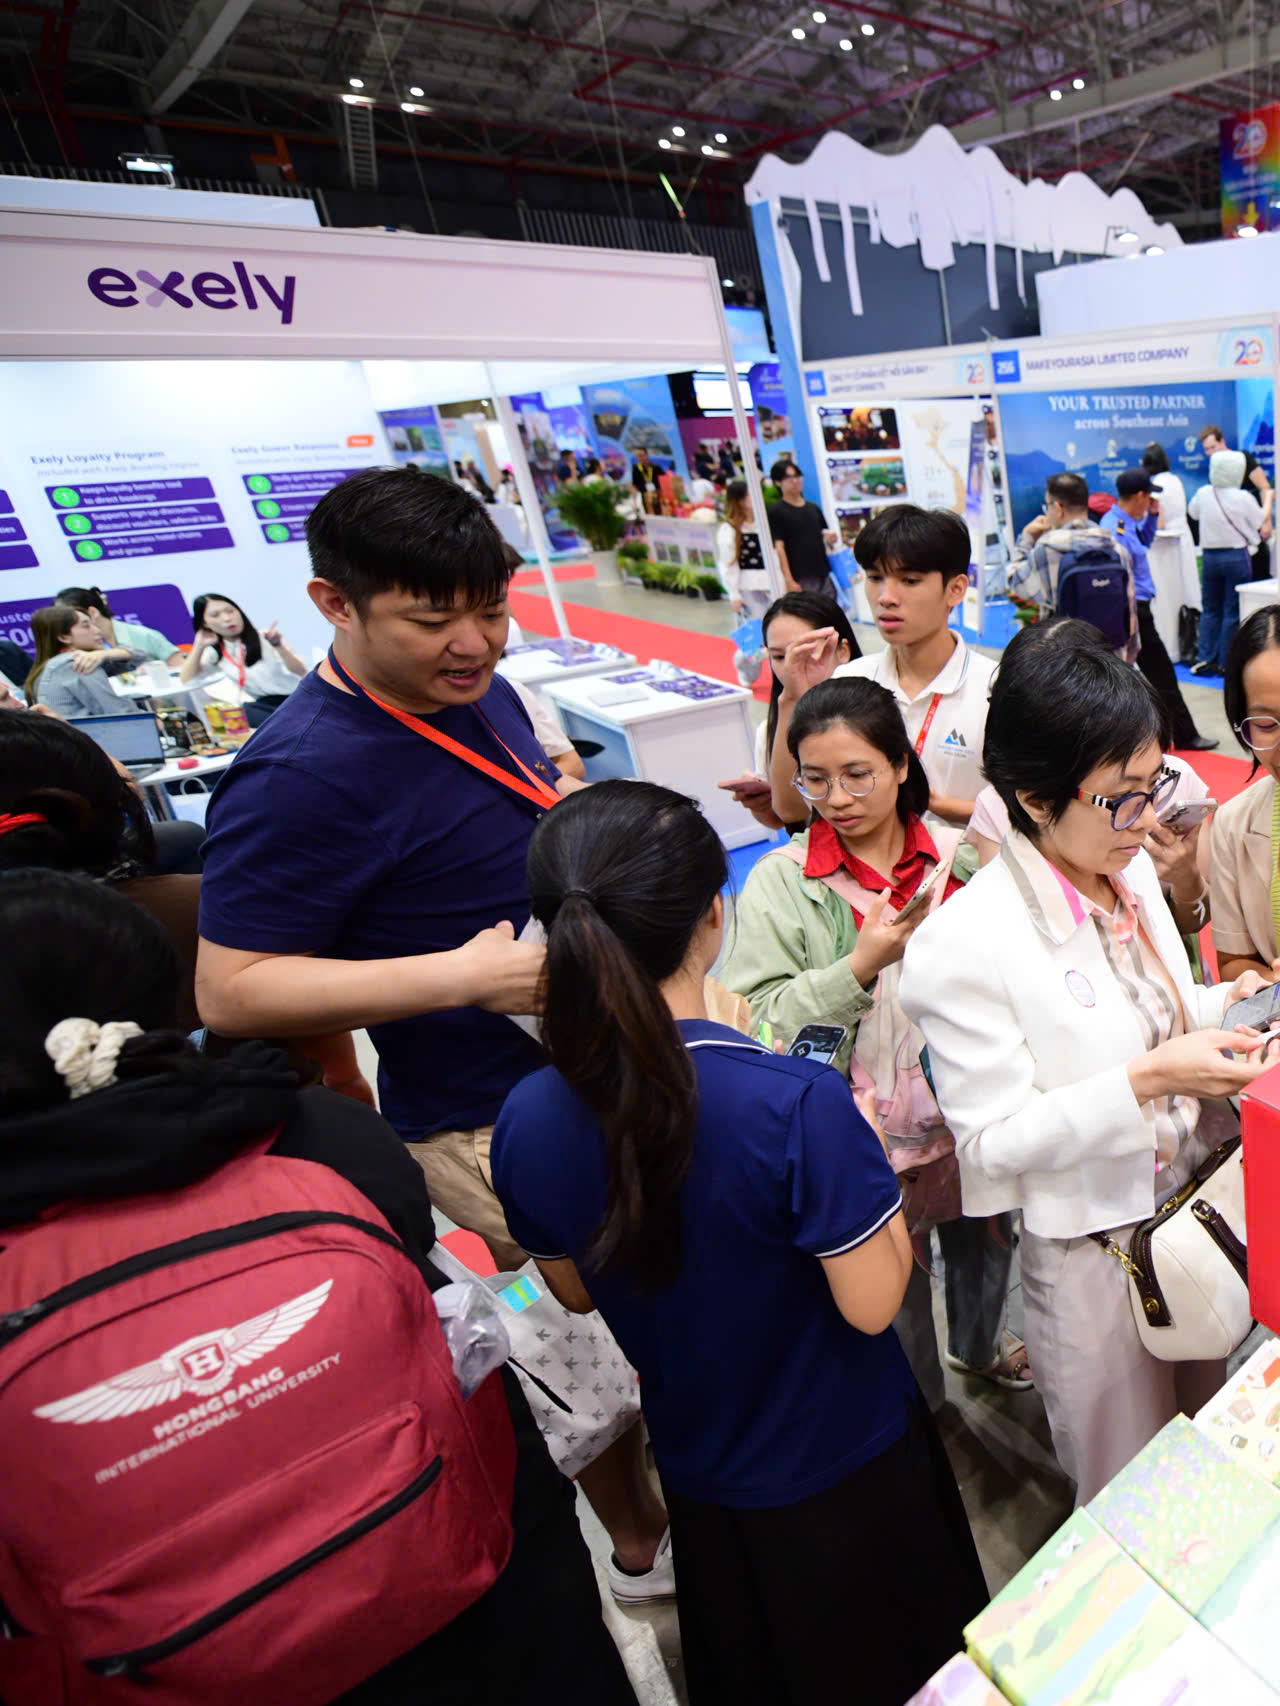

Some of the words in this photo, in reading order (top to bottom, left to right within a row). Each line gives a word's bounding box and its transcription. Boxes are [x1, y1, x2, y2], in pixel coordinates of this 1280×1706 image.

[87, 261, 297, 325] exely
[1026, 352, 1096, 371] MAKEYOURASIA
[1097, 348, 1136, 366] LIMITED
[1138, 345, 1190, 363] COMPANY
[1048, 395, 1089, 412] YOUR
[1093, 394, 1151, 411] TRUSTED
[1152, 394, 1206, 410] PARTNER
[1074, 416, 1111, 430] across
[1112, 414, 1165, 430] Southeast
[1166, 412, 1190, 428] Asia
[31, 454, 64, 466] Exely
[67, 452, 111, 464] Loyalty
[114, 450, 165, 463] Program
[184, 1345, 223, 1379] H
[153, 1366, 286, 1440] HONGBANG
[95, 1407, 242, 1485] INTERNATIONAL
[246, 1352, 342, 1409] UNIVERSITY
